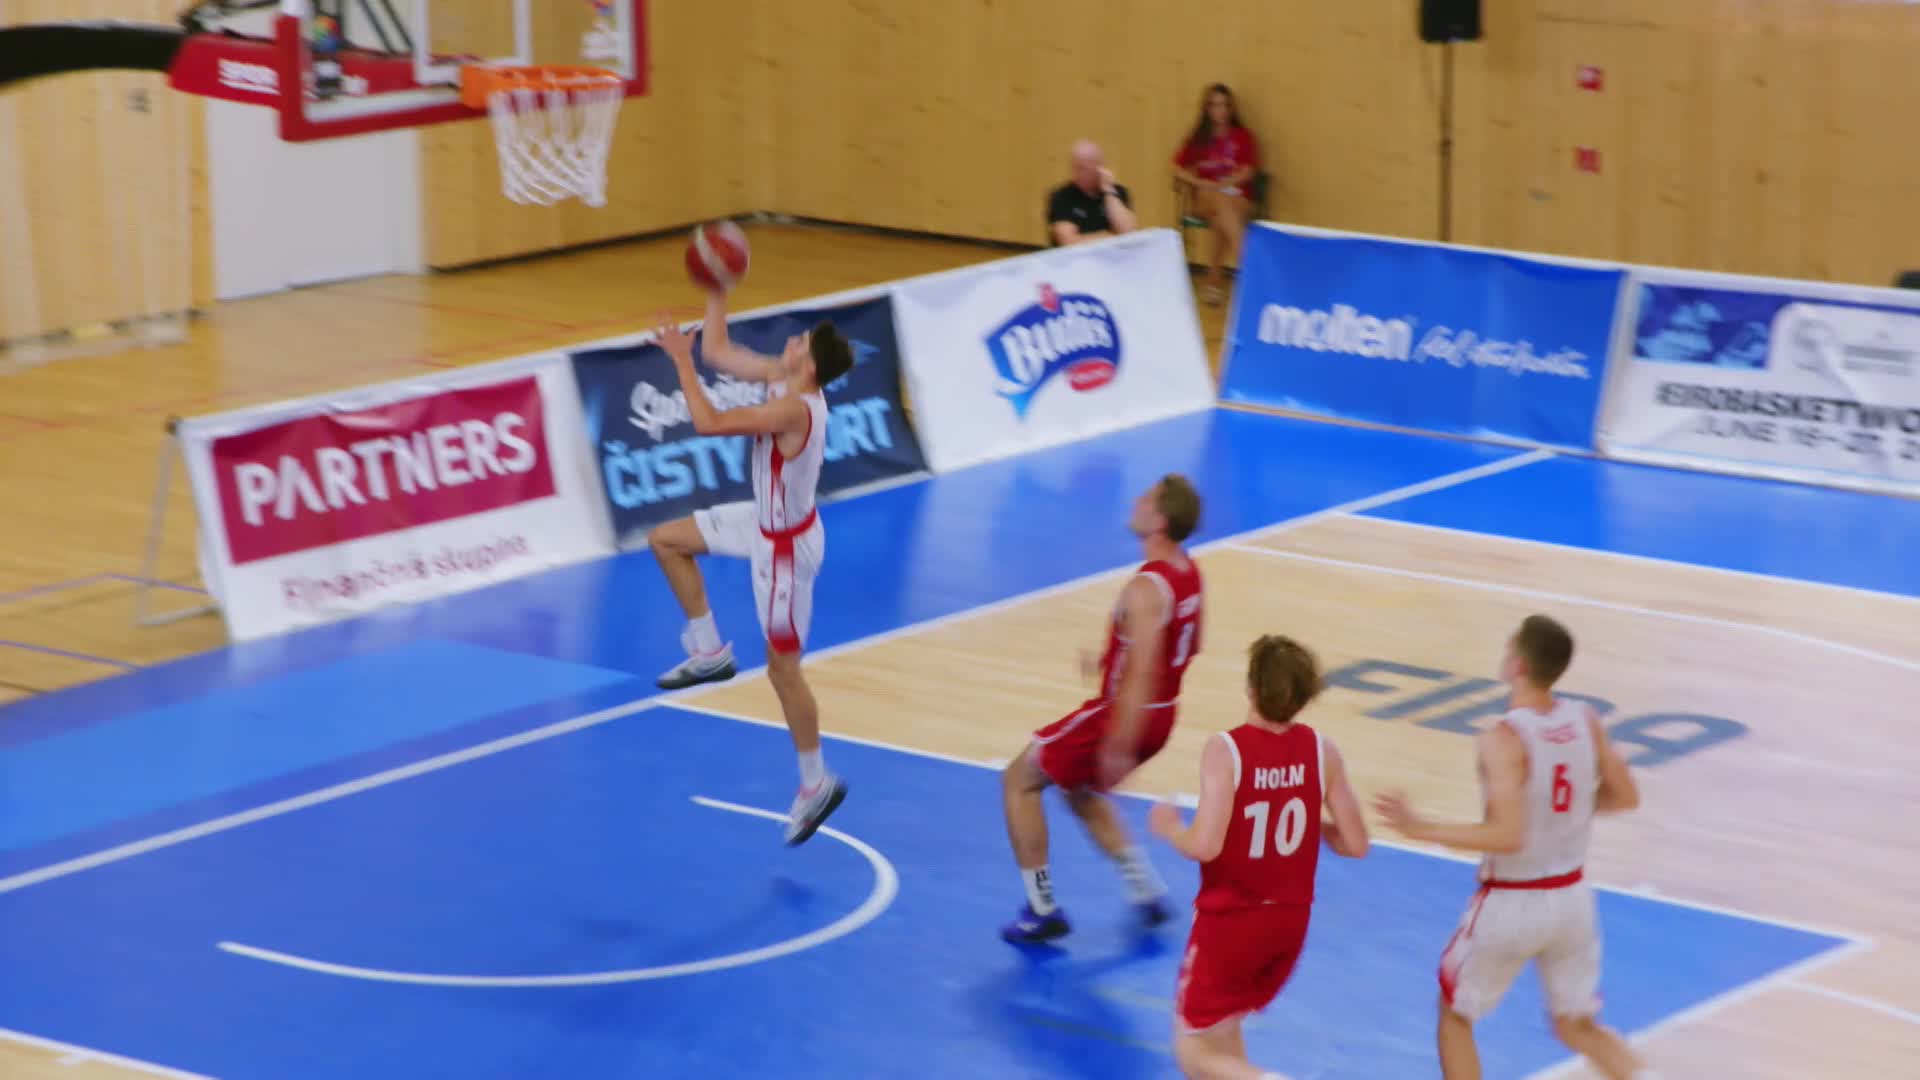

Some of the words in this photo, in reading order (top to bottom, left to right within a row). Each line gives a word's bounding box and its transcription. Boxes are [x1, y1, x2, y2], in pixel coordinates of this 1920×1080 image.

[1258, 303, 1413, 362] molten
[234, 412, 537, 526] PARTNERS
[1254, 764, 1305, 789] HOLM
[1552, 763, 1571, 814] 6
[1244, 797, 1307, 859] 10
